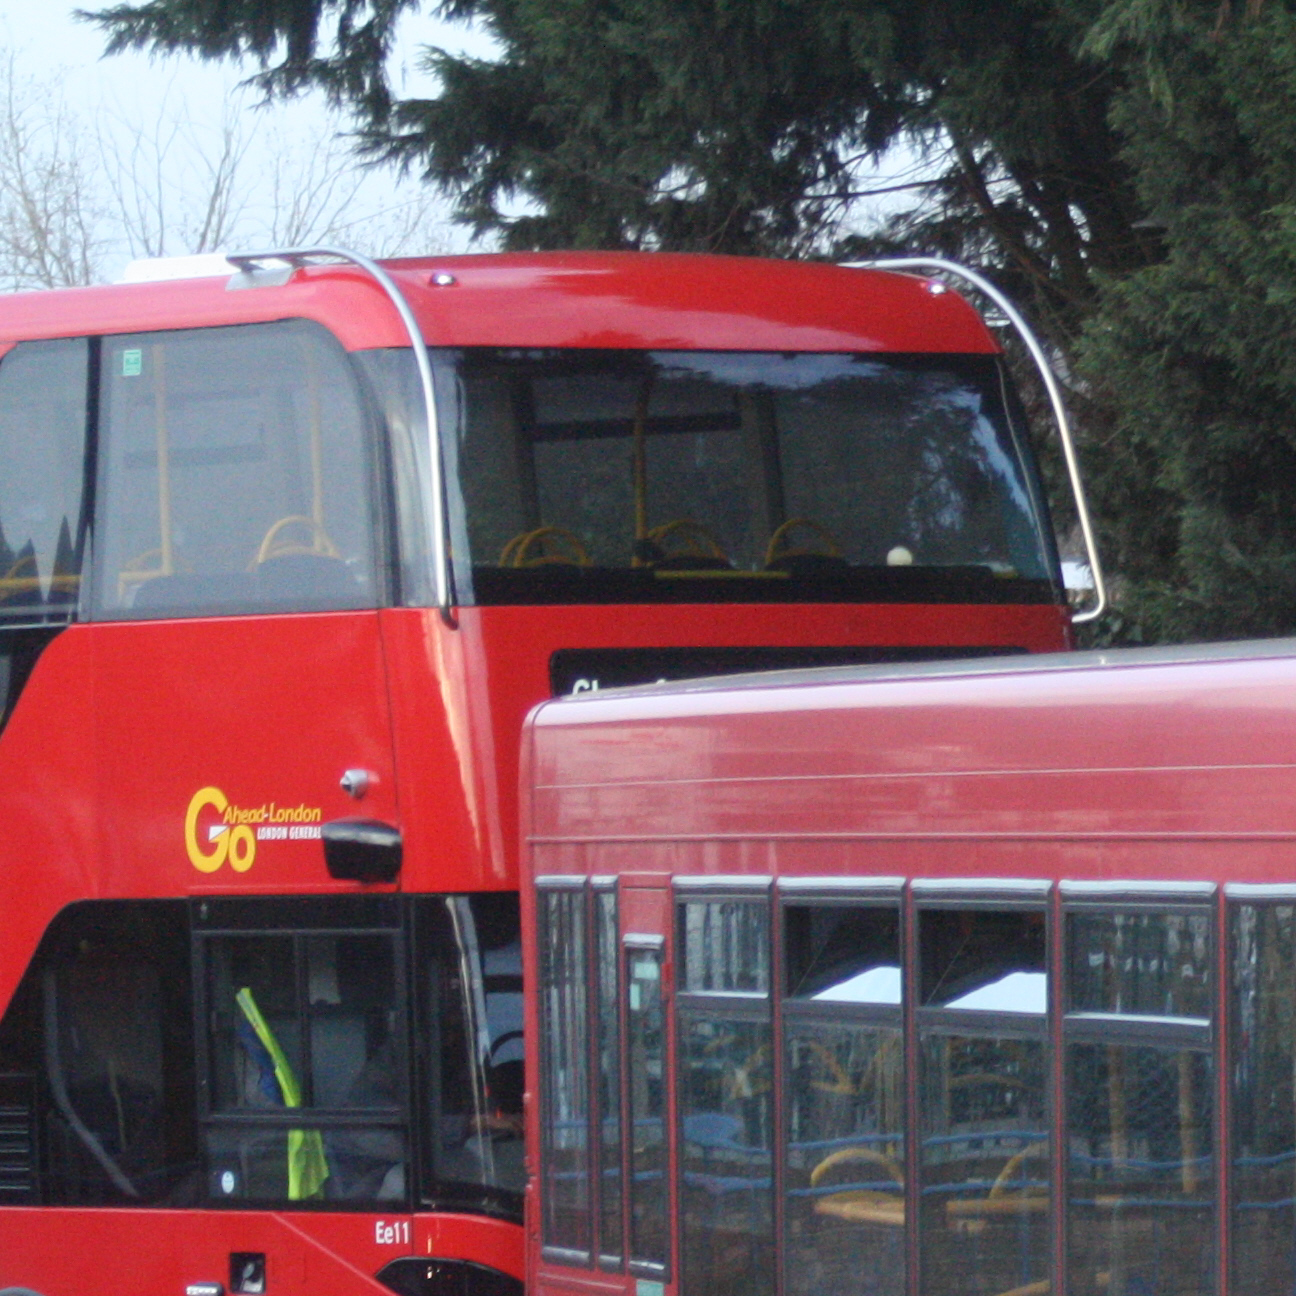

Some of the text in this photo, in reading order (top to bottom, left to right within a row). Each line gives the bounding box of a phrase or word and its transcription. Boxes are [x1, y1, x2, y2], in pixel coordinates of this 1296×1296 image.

[223, 802, 322, 824] Ahead-London
[184, 786, 256, 873] Go
[257, 826, 288, 840] LONDON
[375, 1220, 409, 1244] Ee11
